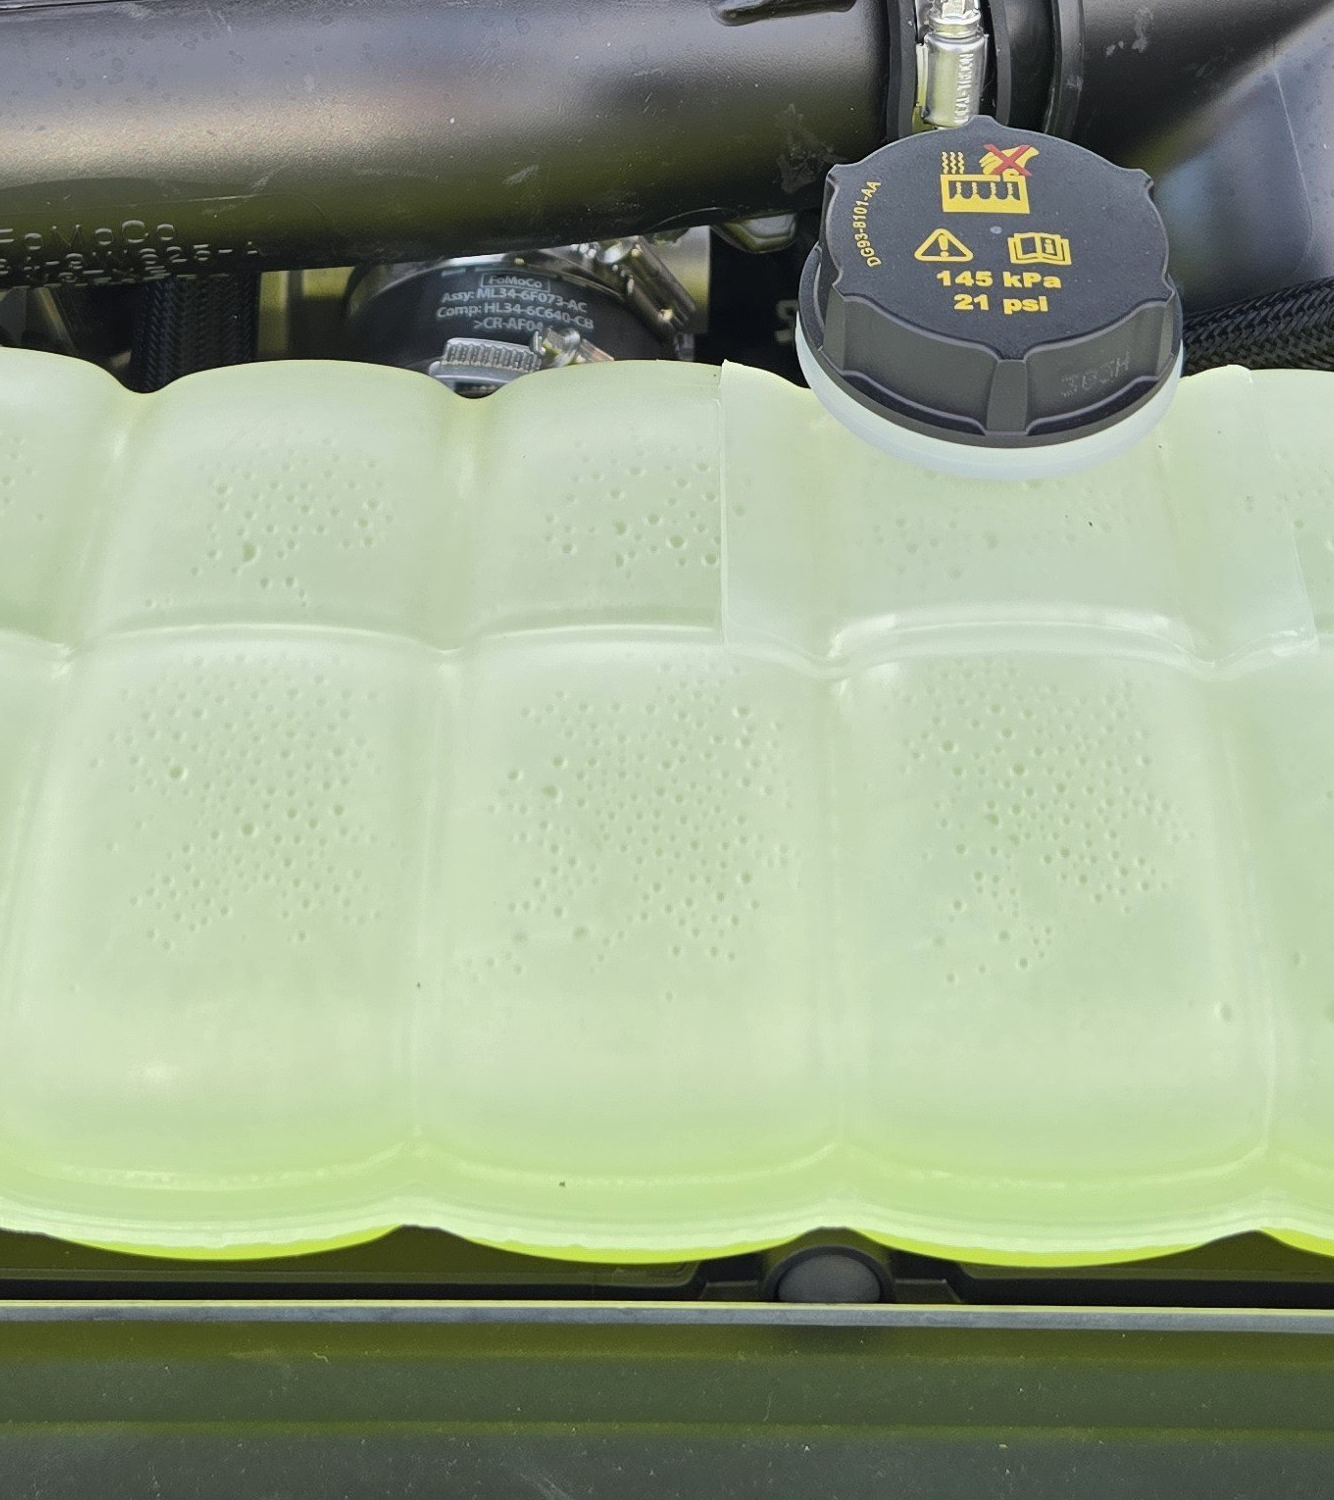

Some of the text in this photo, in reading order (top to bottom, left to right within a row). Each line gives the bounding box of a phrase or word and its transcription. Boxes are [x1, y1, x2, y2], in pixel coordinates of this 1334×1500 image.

[852, 181, 882, 267] DG93-8101-AA
[488, 274, 543, 289] FoMoCo
[936, 270, 1062, 289] 145 kPa
[441, 291, 474, 303] Assy:
[954, 293, 1049, 315] 21 psi
[436, 305, 482, 318] Comp:
